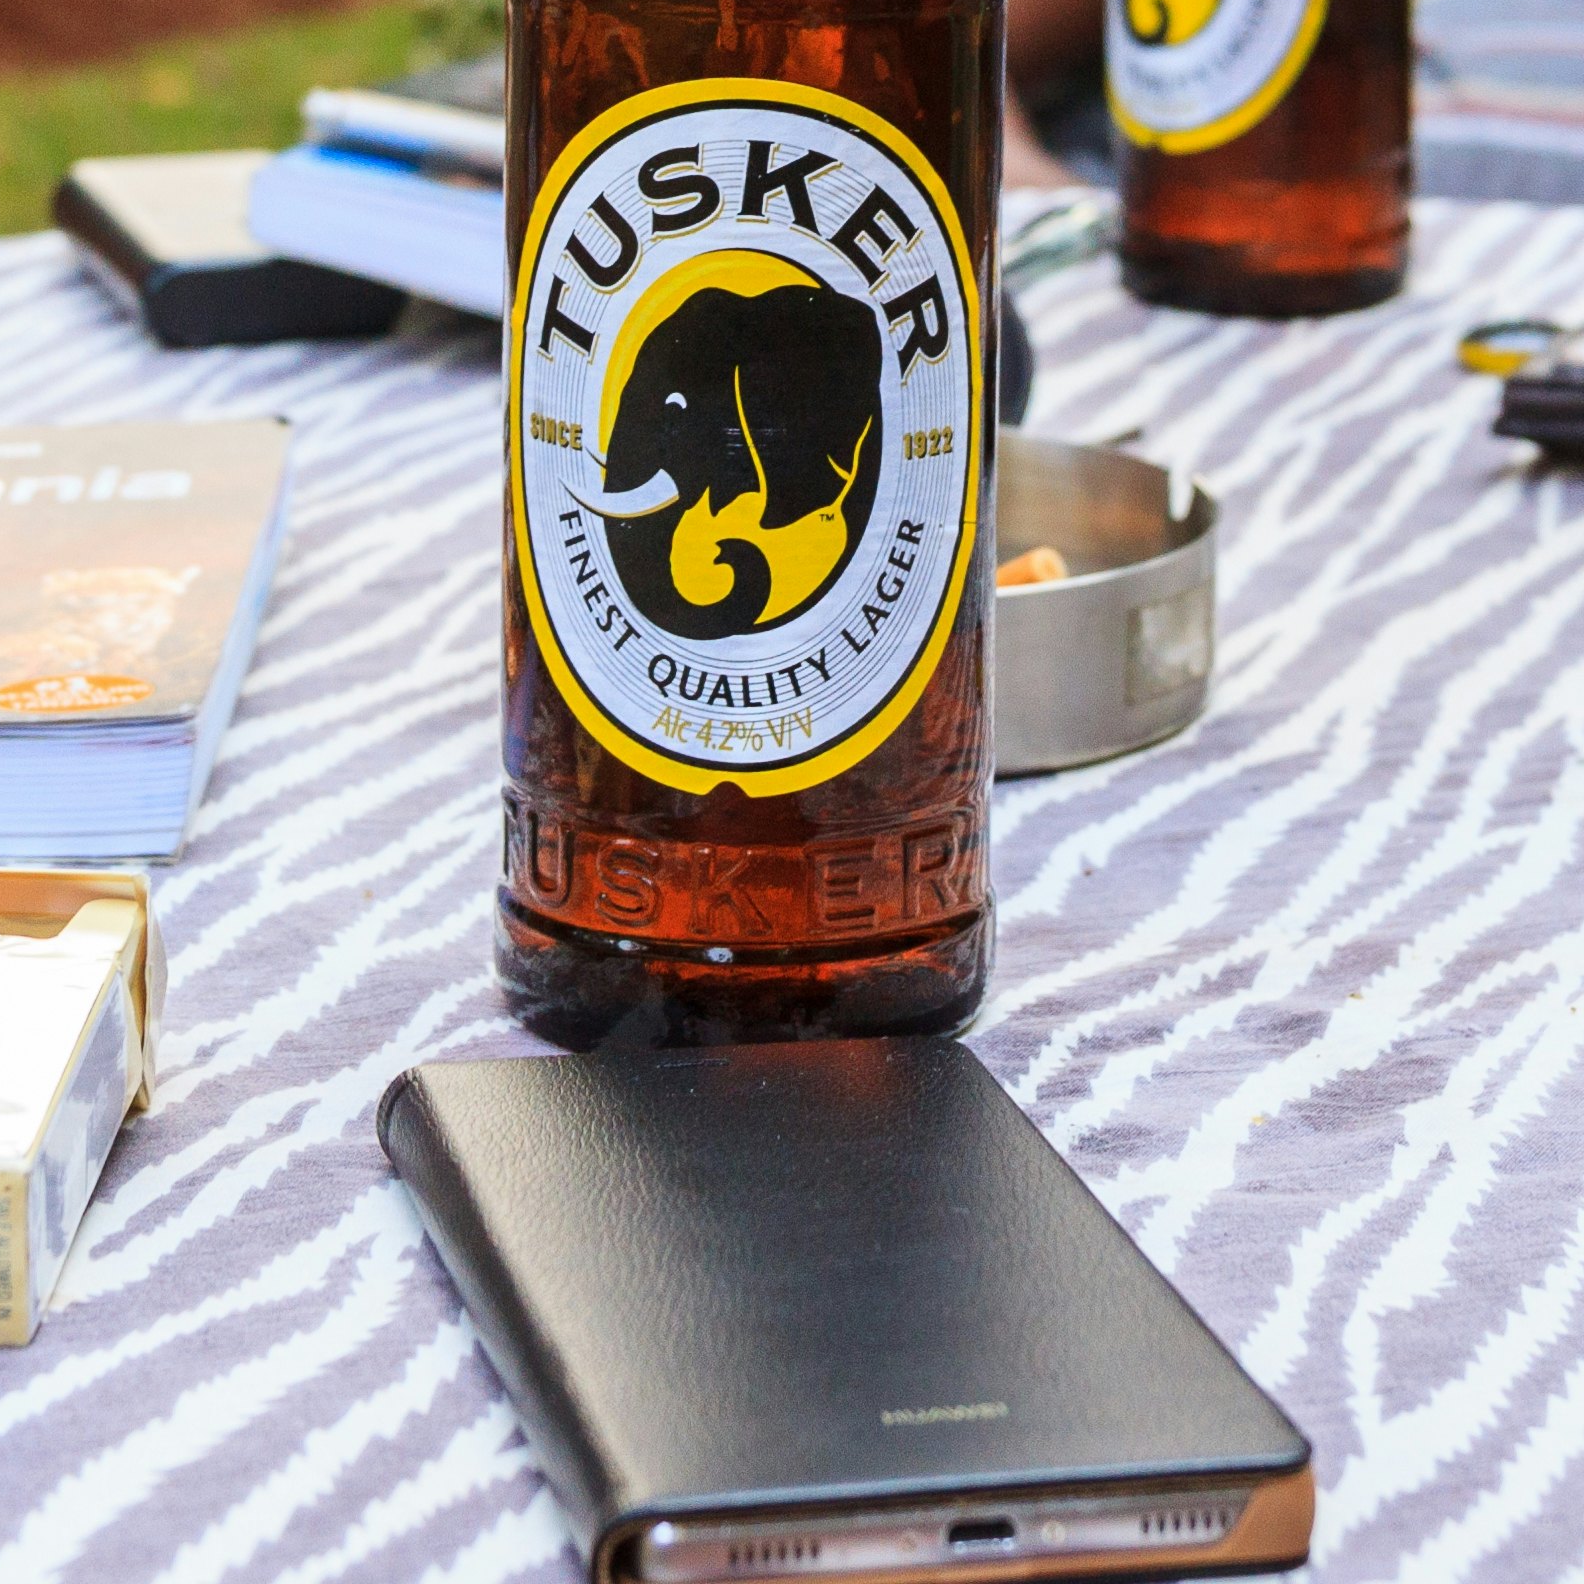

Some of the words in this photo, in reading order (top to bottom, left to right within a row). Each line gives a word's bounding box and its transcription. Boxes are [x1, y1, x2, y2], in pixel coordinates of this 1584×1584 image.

[536, 139, 952, 382] TUSKER
[529, 411, 584, 452] SINCE
[903, 426, 954, 460] 1922
[557, 508, 643, 654] FINEST
[646, 650, 832, 709] QUALITY
[849, 516, 926, 657] LAGER
[651, 705, 692, 744] Alc
[695, 718, 764, 752] 4.2%
[502, 808, 960, 937] USKER
